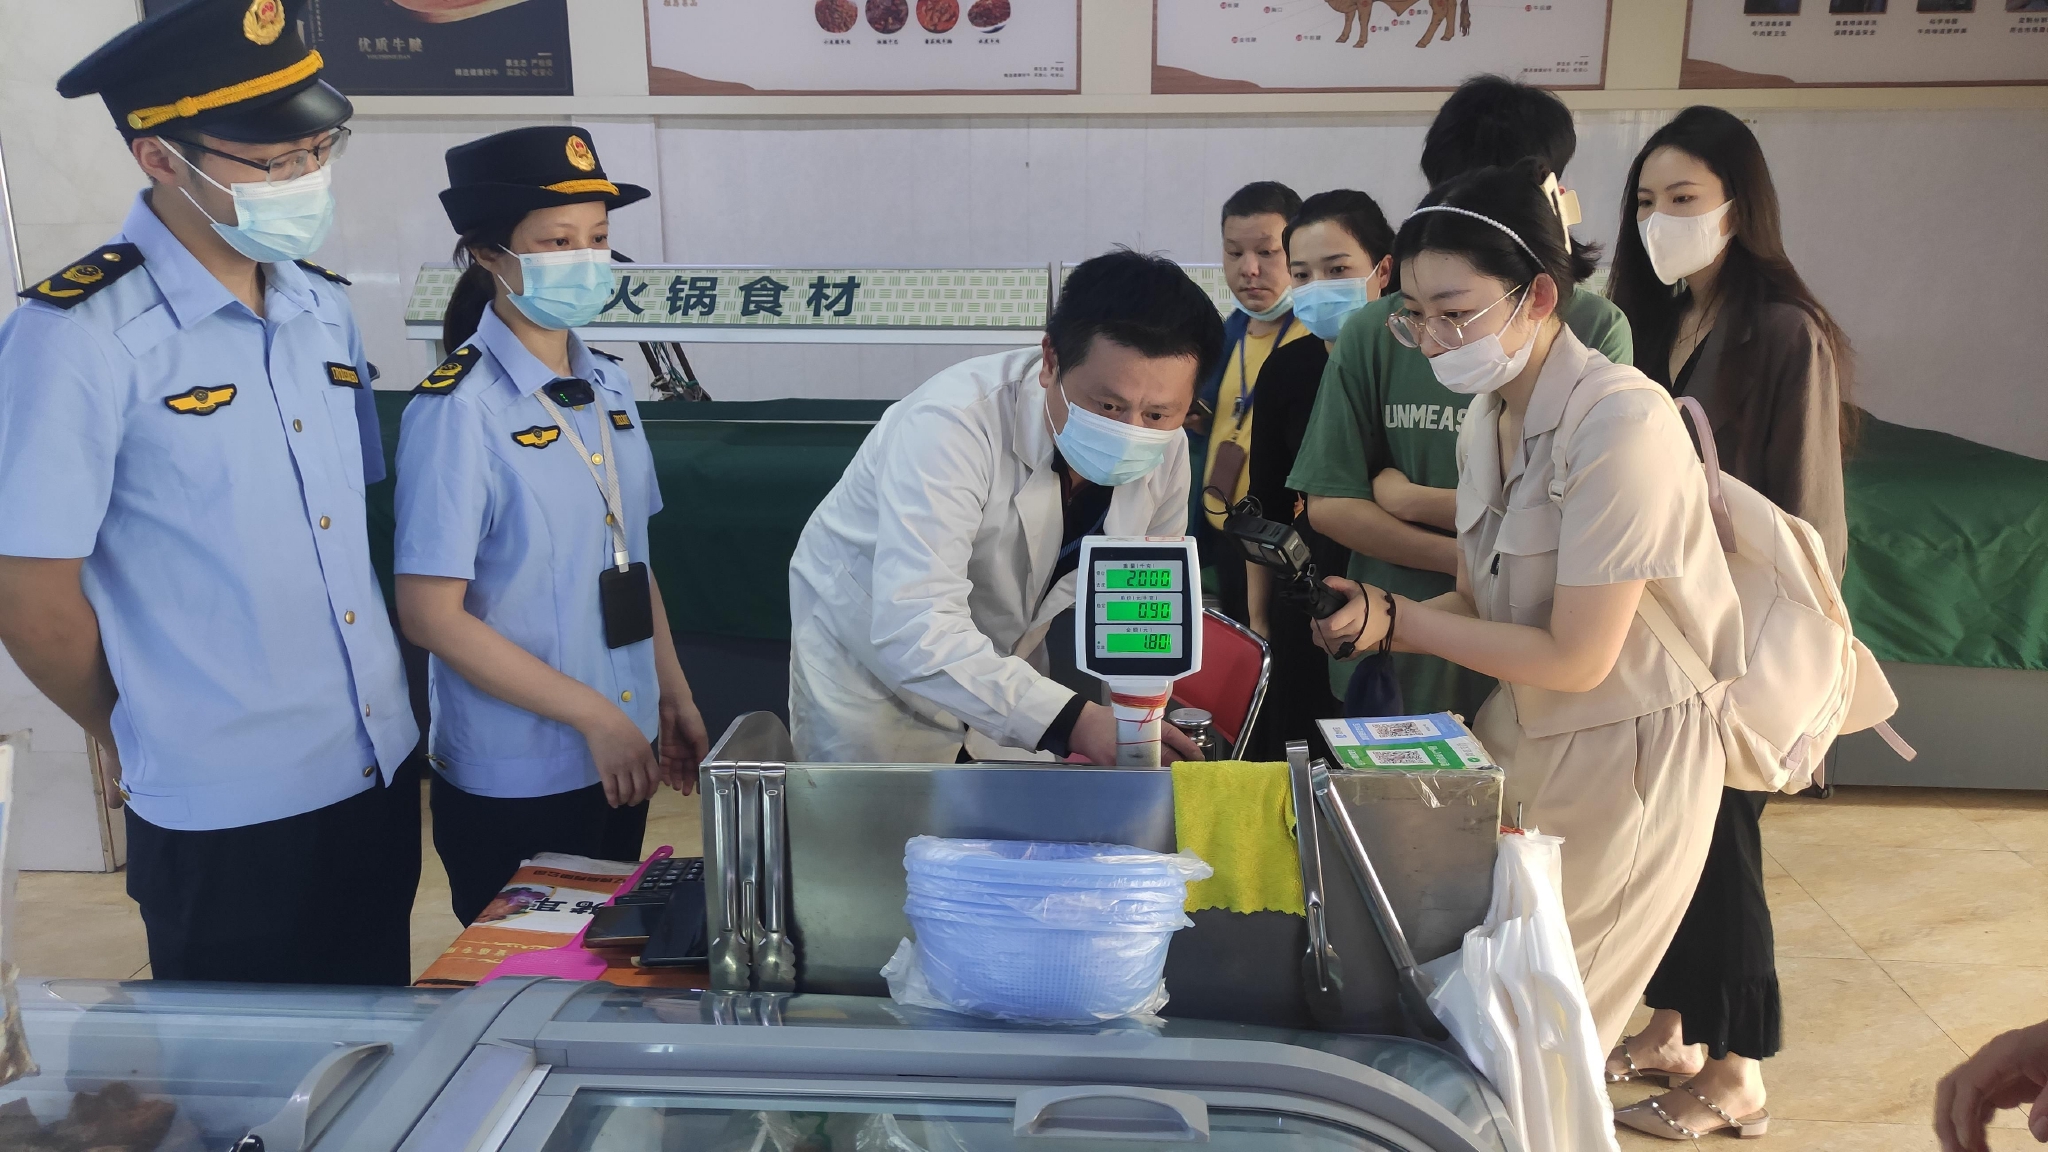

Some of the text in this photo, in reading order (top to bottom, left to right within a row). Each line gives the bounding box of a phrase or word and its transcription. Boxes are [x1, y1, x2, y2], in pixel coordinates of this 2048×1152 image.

[599, 275, 861, 317] 火锅食材
[1138, 602, 1170, 619] 0.90
